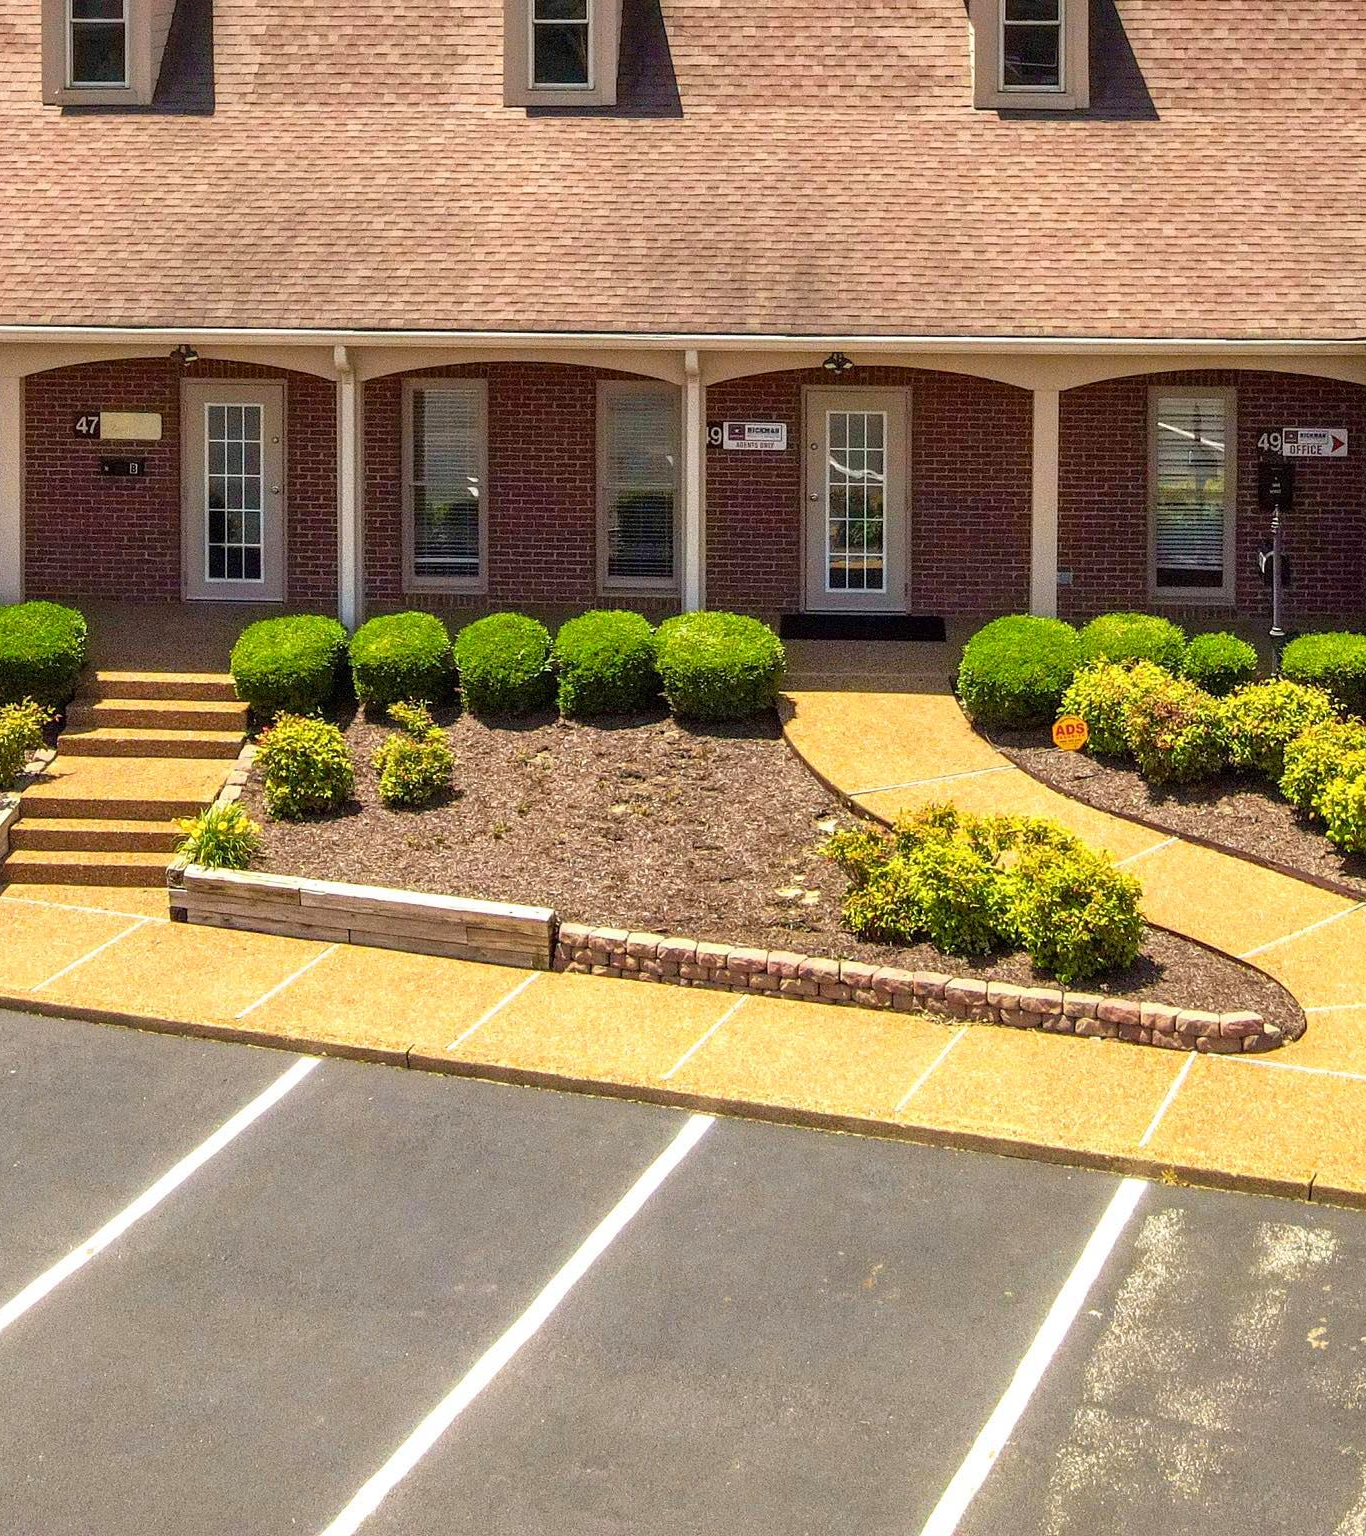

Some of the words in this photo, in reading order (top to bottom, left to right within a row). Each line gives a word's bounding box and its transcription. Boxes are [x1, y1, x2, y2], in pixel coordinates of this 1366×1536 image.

[75, 416, 99, 434] 47
[1257, 432, 1282, 452] 49
[1289, 444, 1323, 455] OFFICE
[129, 462, 138, 474] B
[1056, 723, 1085, 736] ADS
